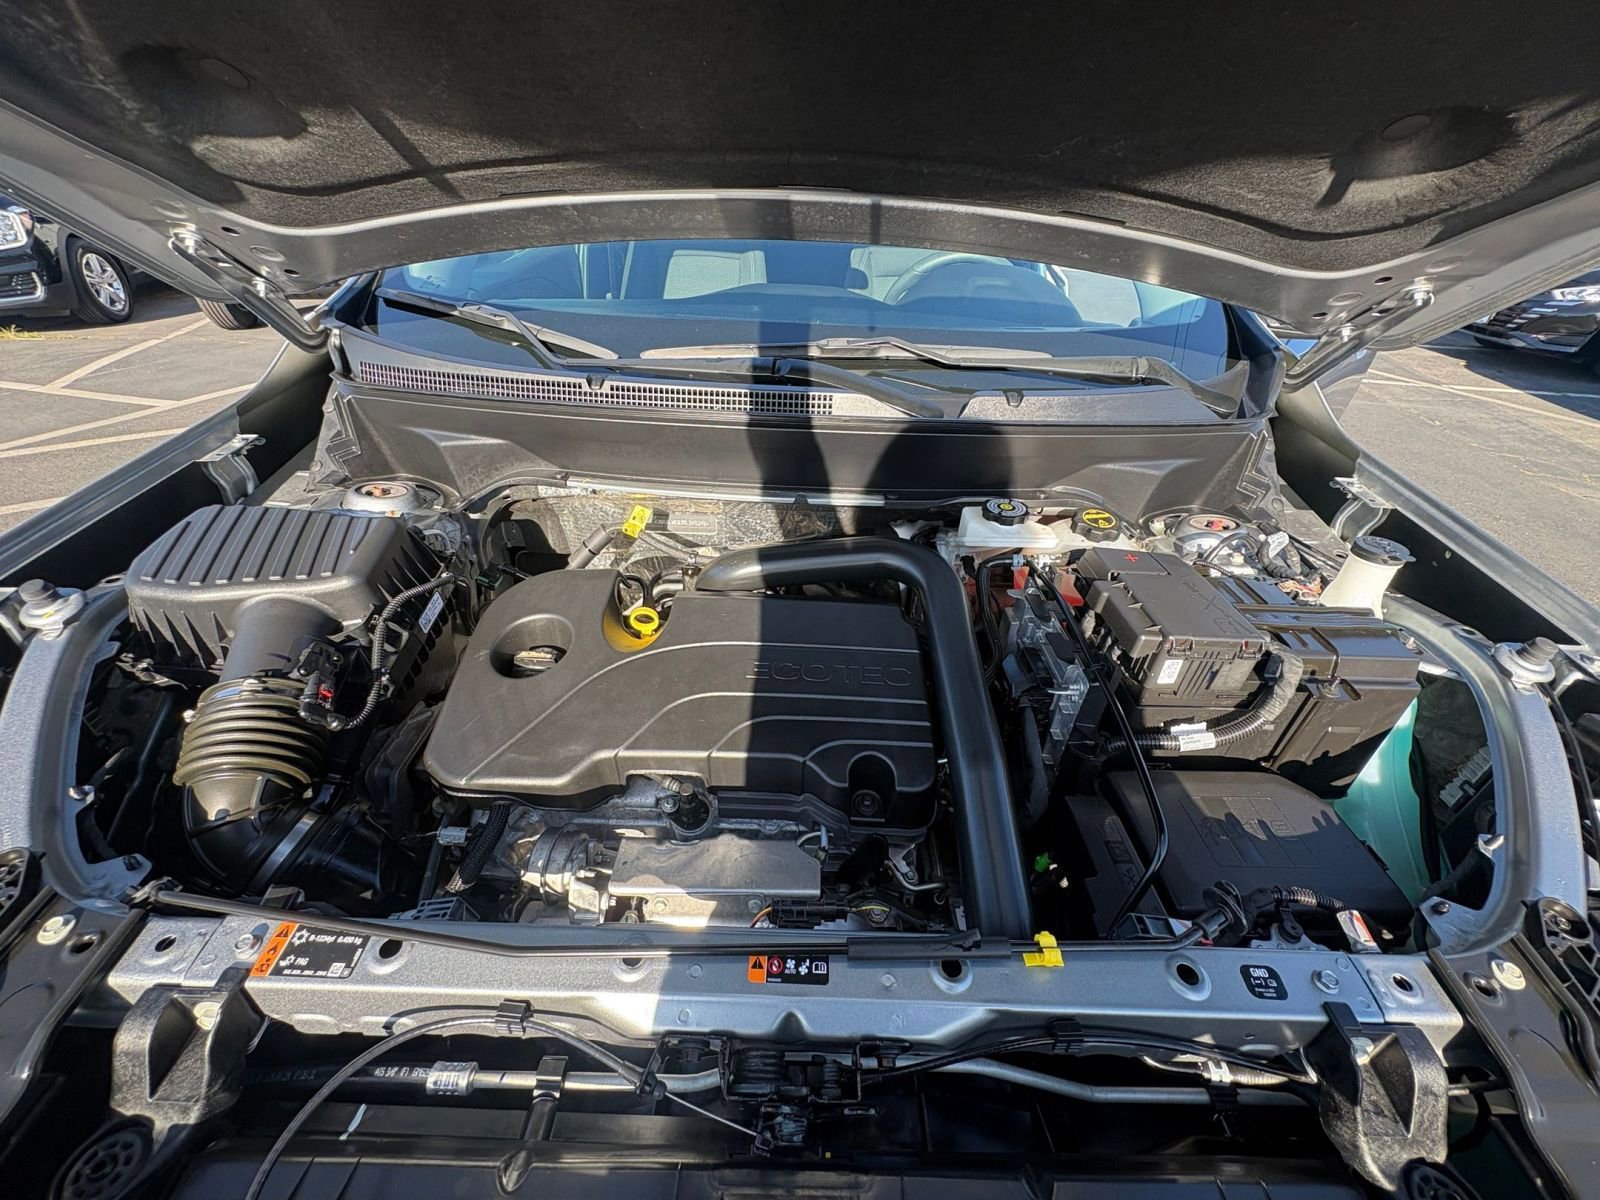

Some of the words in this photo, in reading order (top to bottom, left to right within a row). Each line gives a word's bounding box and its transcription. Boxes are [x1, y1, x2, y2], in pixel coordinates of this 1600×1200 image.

[746, 661, 912, 687] ECOTEC
[309, 934, 336, 944] R-1234yf
[353, 936, 362, 945] kg
[294, 957, 310, 966] PAG
[1249, 967, 1269, 978] GND
